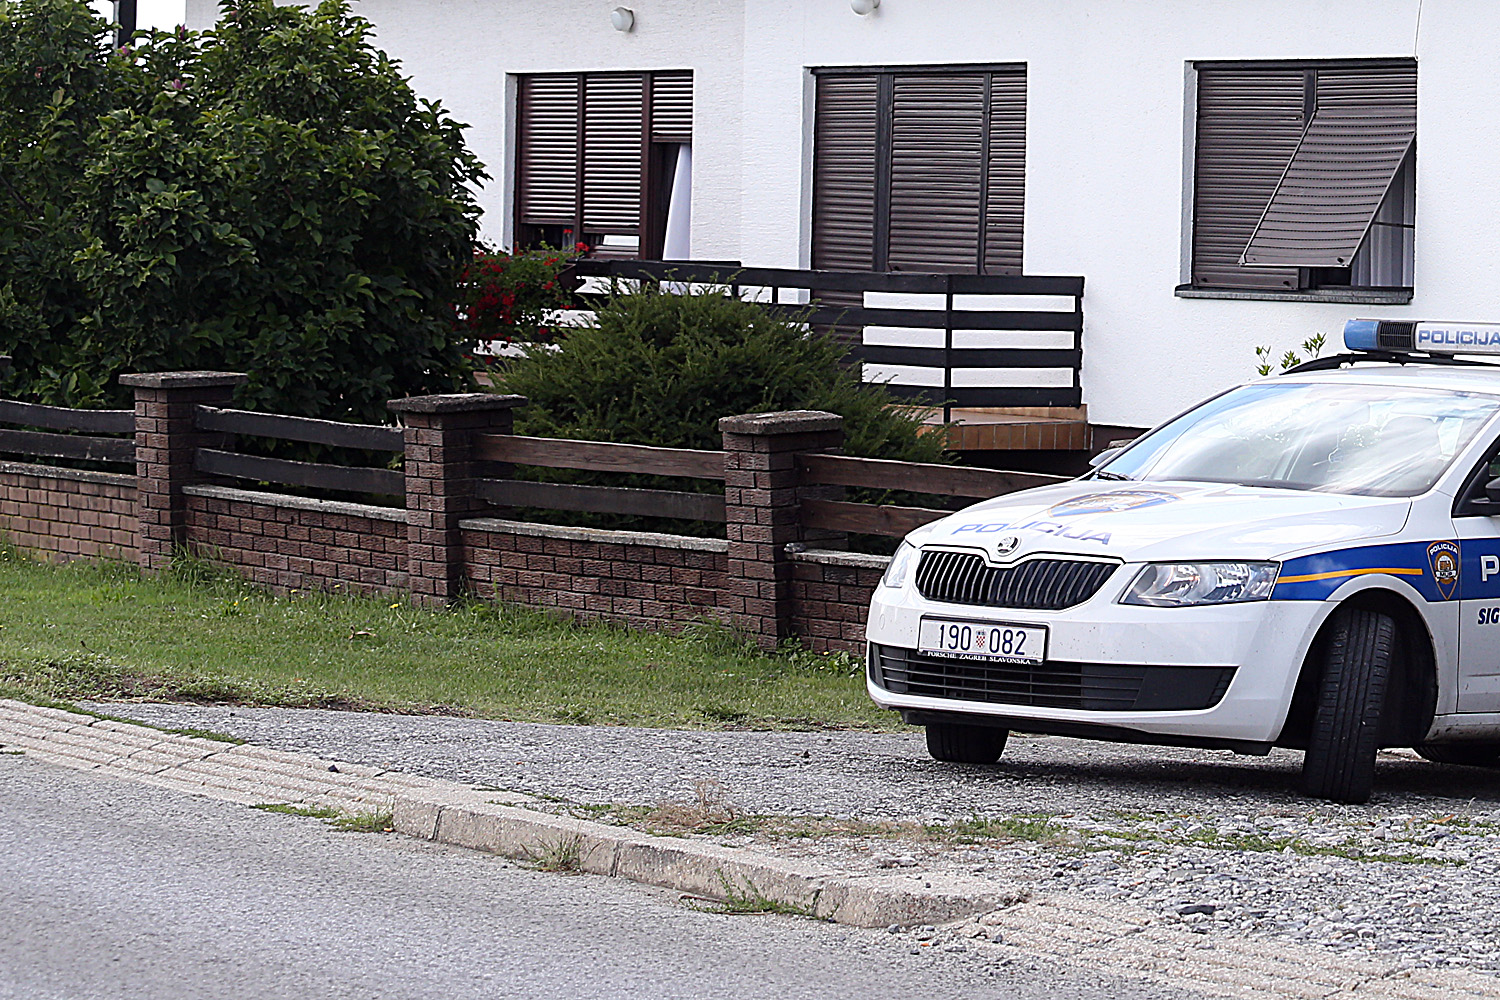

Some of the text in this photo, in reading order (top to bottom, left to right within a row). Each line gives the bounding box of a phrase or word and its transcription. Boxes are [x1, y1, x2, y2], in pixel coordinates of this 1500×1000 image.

[1429, 543, 1458, 556] POLICIJA
[938, 624, 1027, 656] 190 082
[927, 651, 1031, 665] PORSCHE ZAGREB SLAVONSKA
